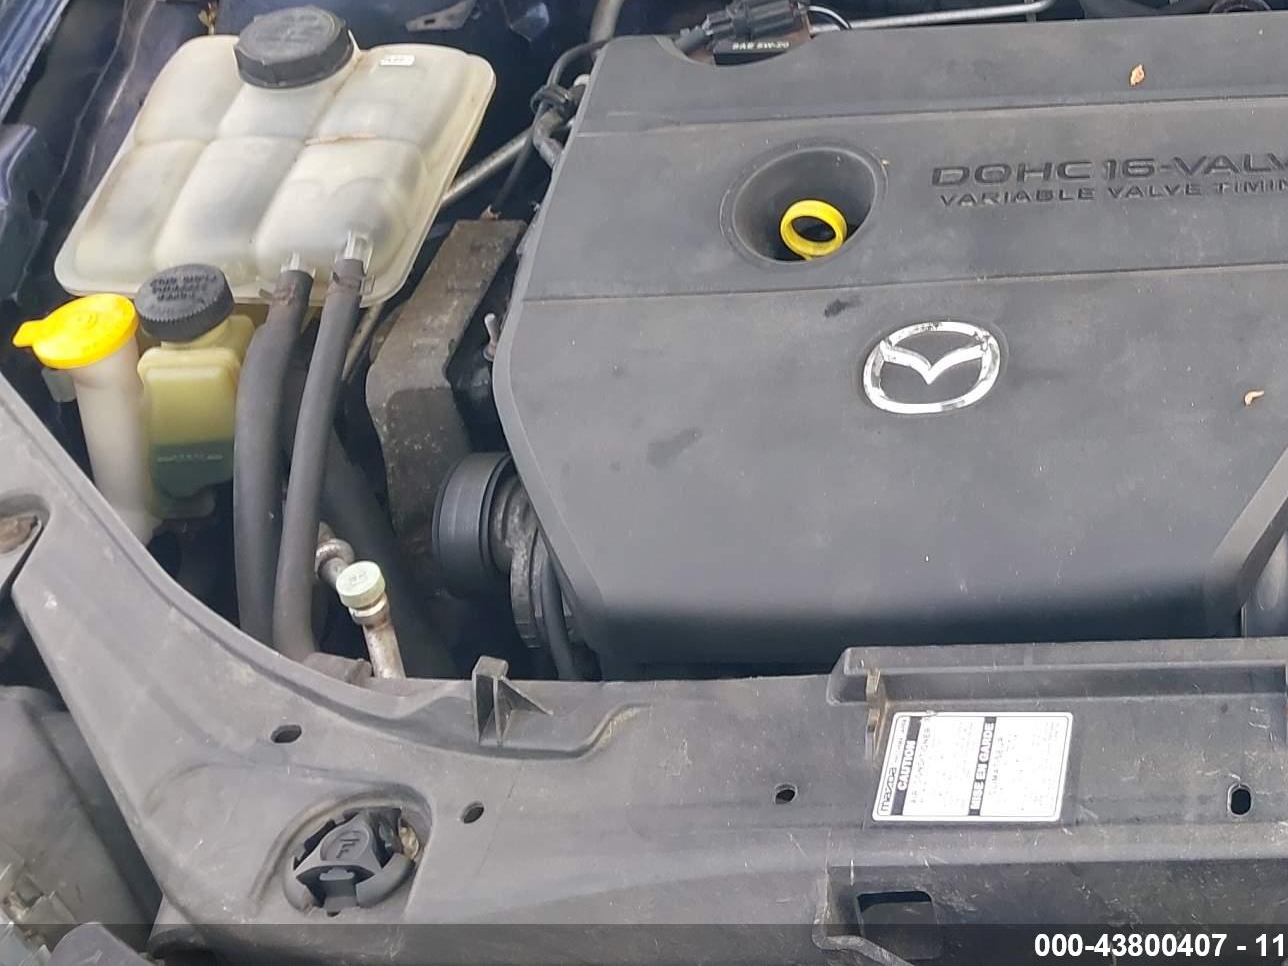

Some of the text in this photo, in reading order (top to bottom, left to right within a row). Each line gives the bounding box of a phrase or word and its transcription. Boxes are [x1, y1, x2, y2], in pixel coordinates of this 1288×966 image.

[931, 160, 1093, 187] DOHC
[940, 186, 1096, 208] VARIABLE
[1107, 183, 1202, 198] VALVE
[896, 739, 917, 791] CAUTION
[969, 722, 995, 810] MISE EN GARDE
